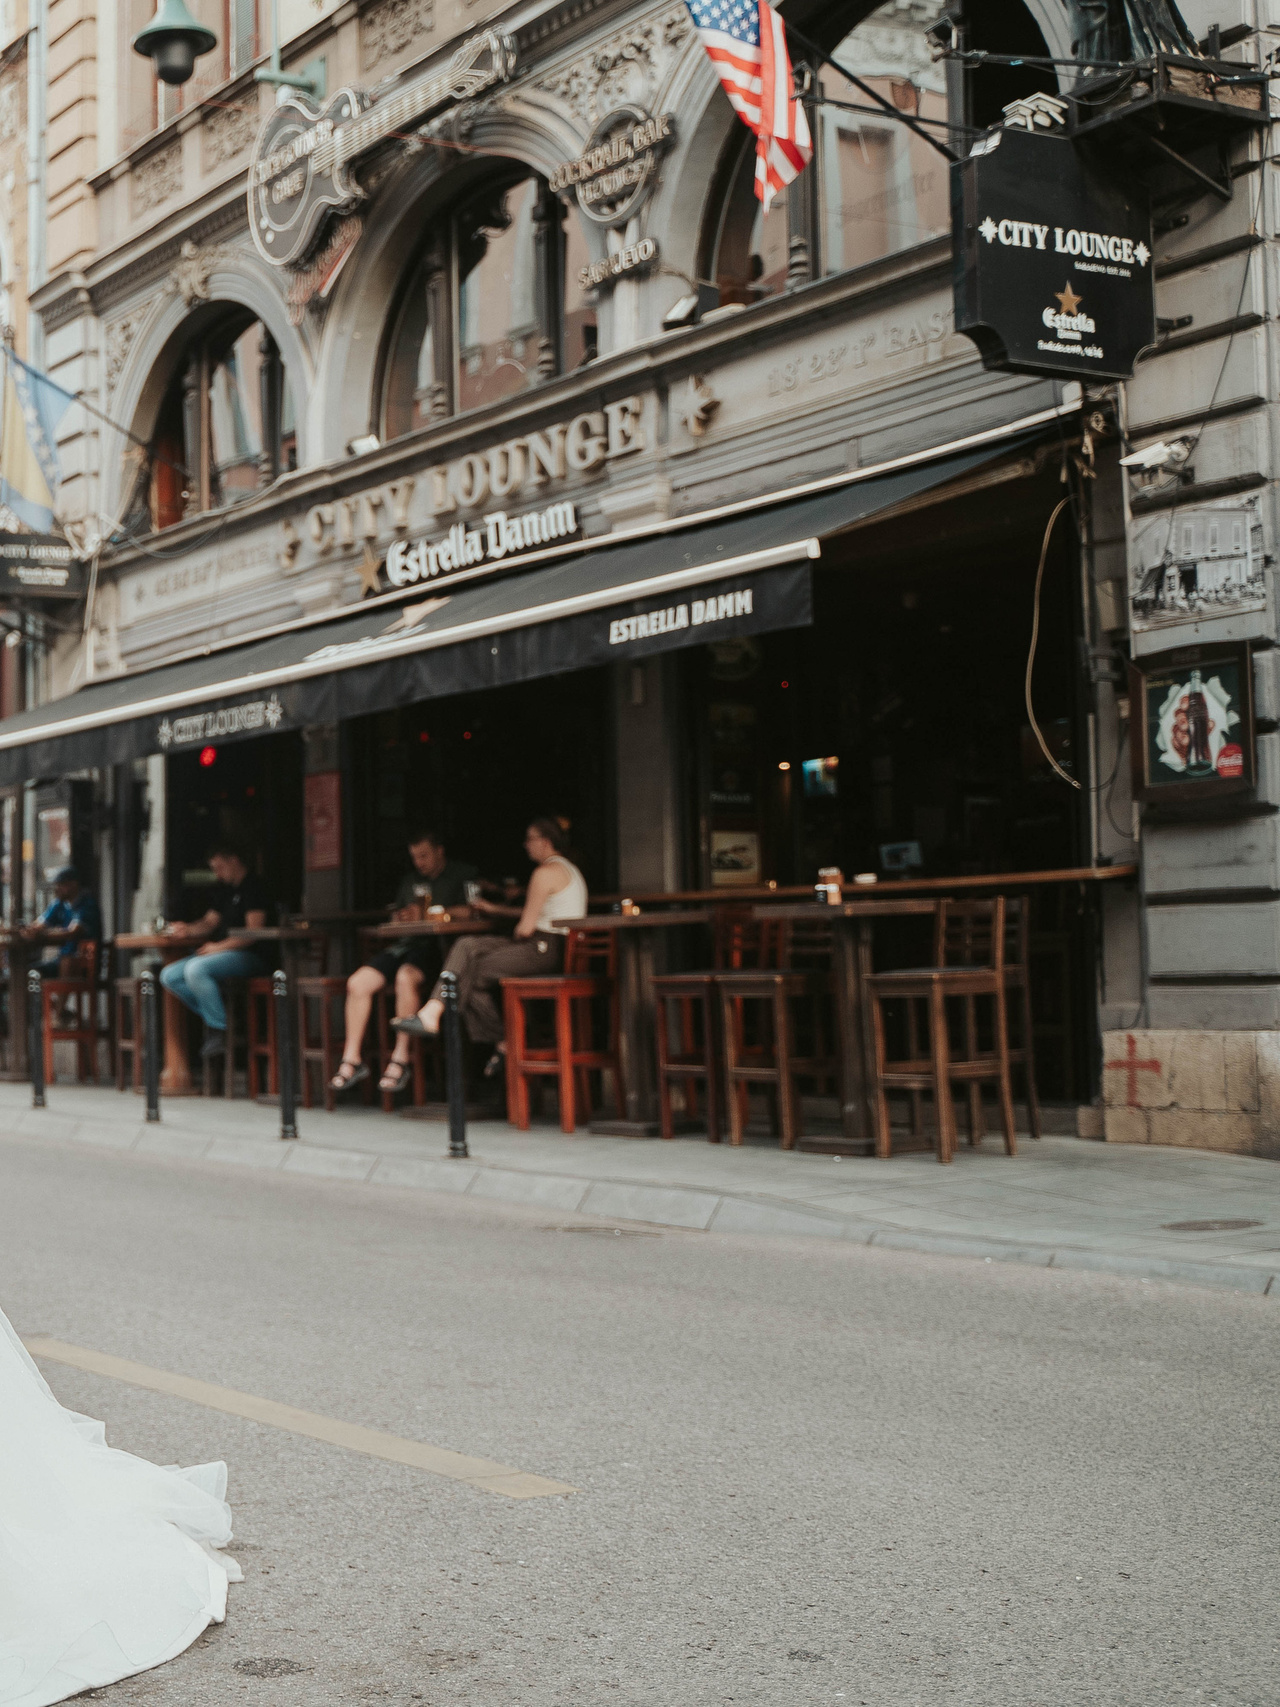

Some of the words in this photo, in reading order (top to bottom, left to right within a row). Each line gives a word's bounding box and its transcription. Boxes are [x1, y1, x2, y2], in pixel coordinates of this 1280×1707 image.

[998, 219, 1049, 250] CITY
[1053, 227, 1135, 264] LOUNGE
[1041, 306, 1096, 334] Estrella
[306, 477, 415, 556] CITY
[424, 396, 644, 517] LOUNGE
[386, 521, 484, 587] Estrella
[483, 500, 578, 559] Damm
[609, 602, 689, 645] ESTRELLA
[690, 588, 754, 627] DAMM
[172, 713, 205, 744] CITY
[204, 700, 266, 738] LOUNGE
